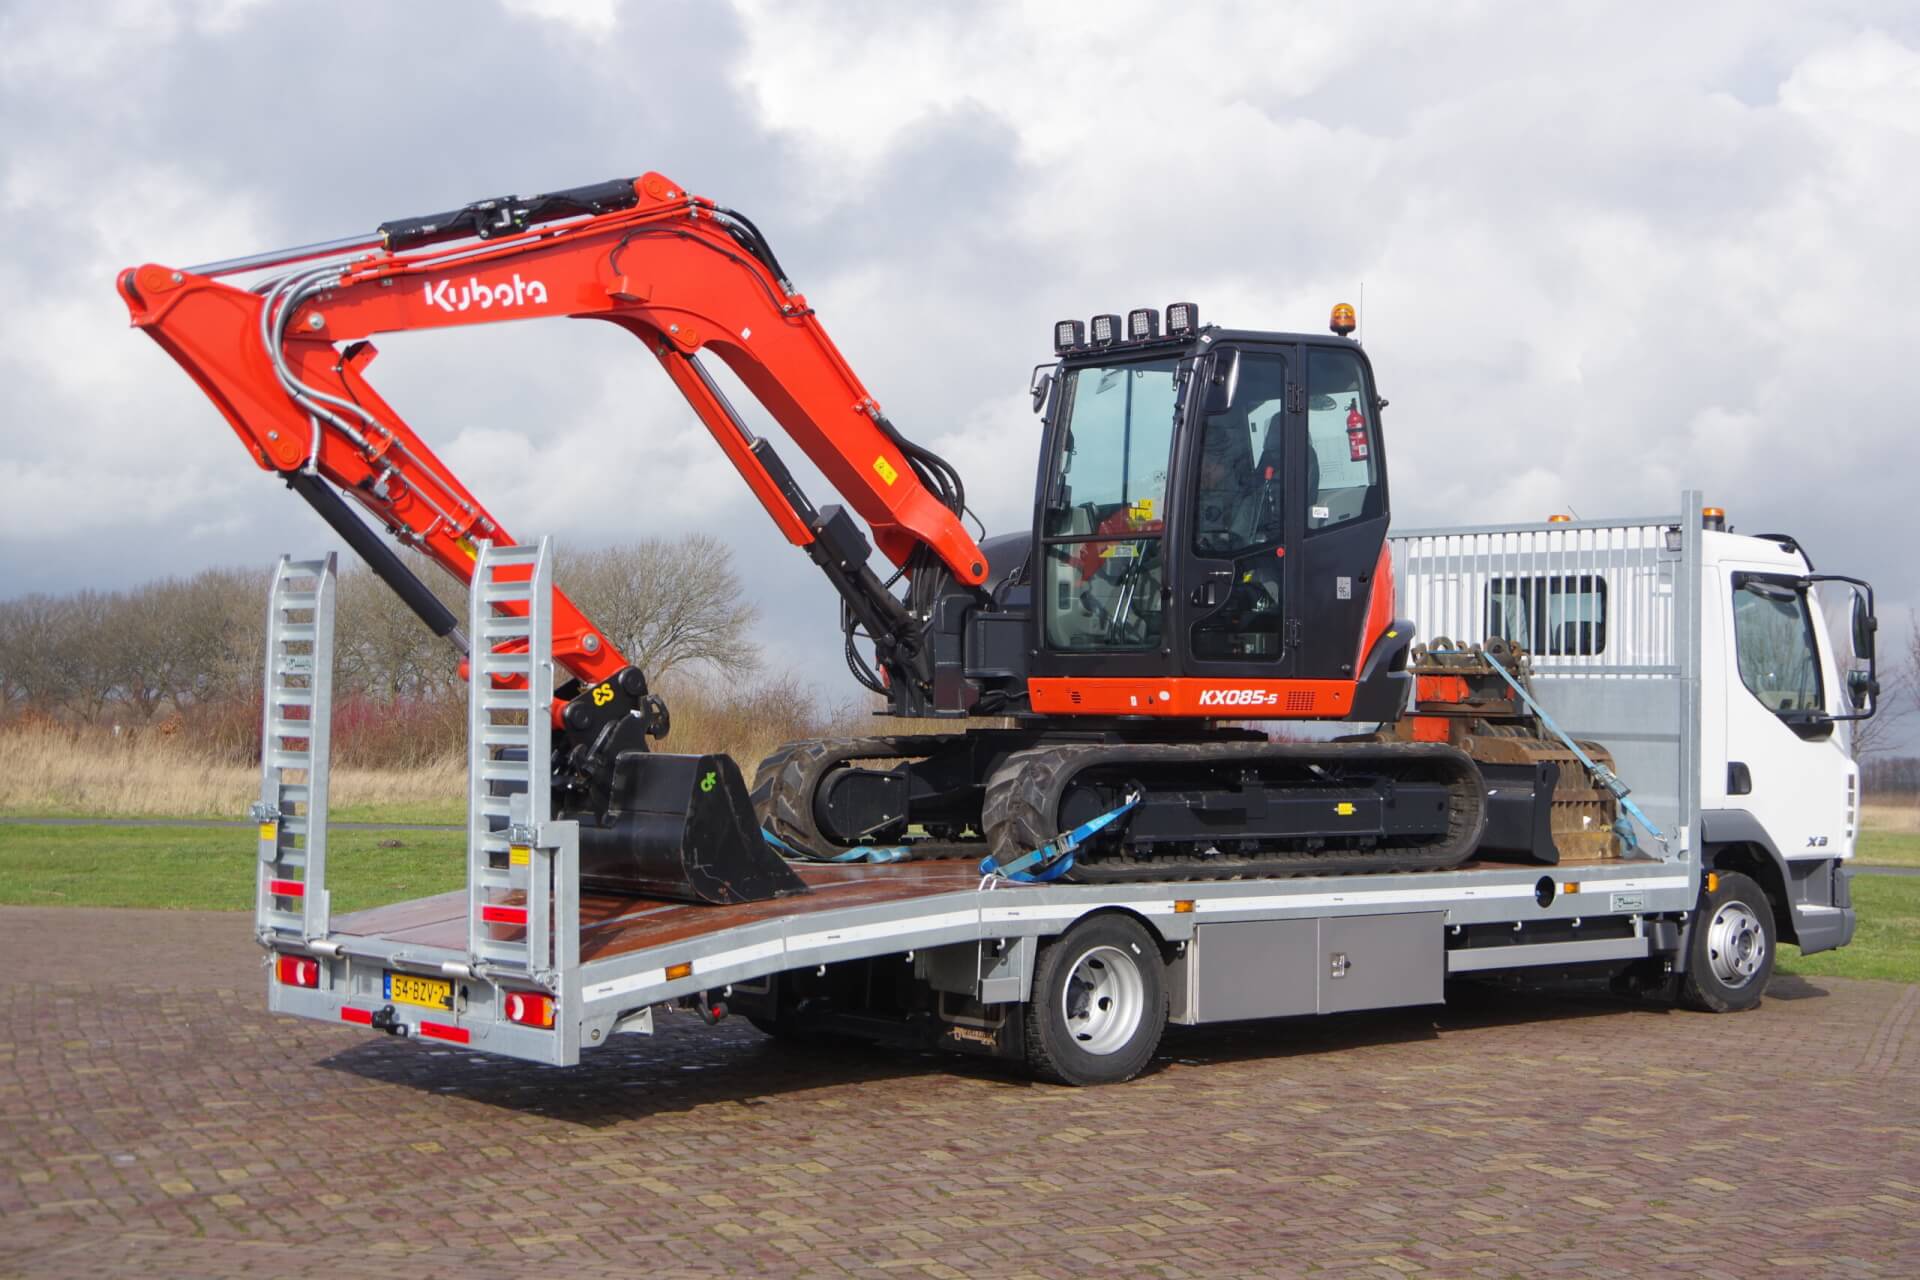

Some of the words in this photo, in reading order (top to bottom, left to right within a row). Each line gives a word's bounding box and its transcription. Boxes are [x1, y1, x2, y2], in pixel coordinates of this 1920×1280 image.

[424, 273, 548, 312] Kubota
[1199, 689, 1278, 705] KX085-5
[394, 978, 445, 1004] 54-BZV-2
